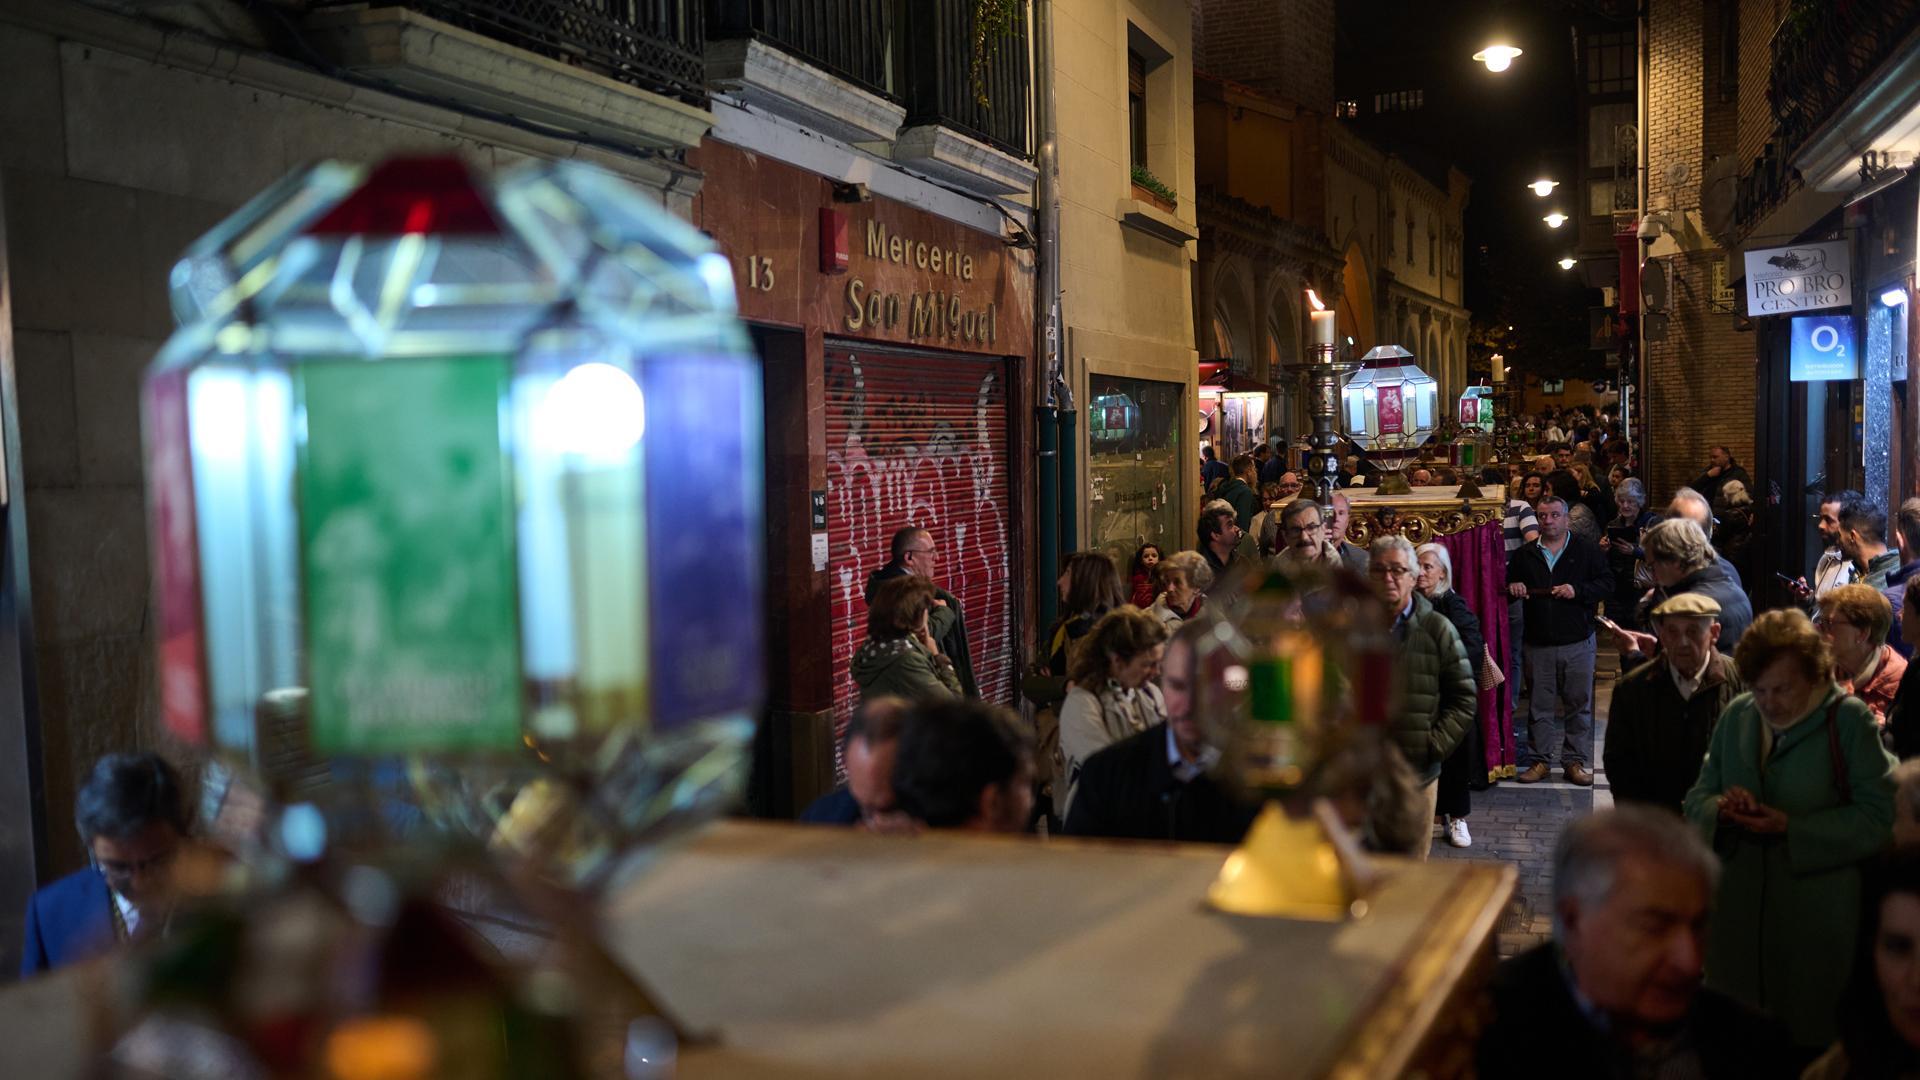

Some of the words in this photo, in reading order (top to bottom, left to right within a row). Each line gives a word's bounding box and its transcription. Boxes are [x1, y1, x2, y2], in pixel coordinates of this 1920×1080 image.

[748, 255, 774, 291] 13
[1755, 279, 1795, 298] PRO
[1803, 273, 1844, 293] BRO
[845, 277, 900, 332] San
[909, 290, 996, 343] Miguel
[1761, 294, 1839, 311] CENTRO
